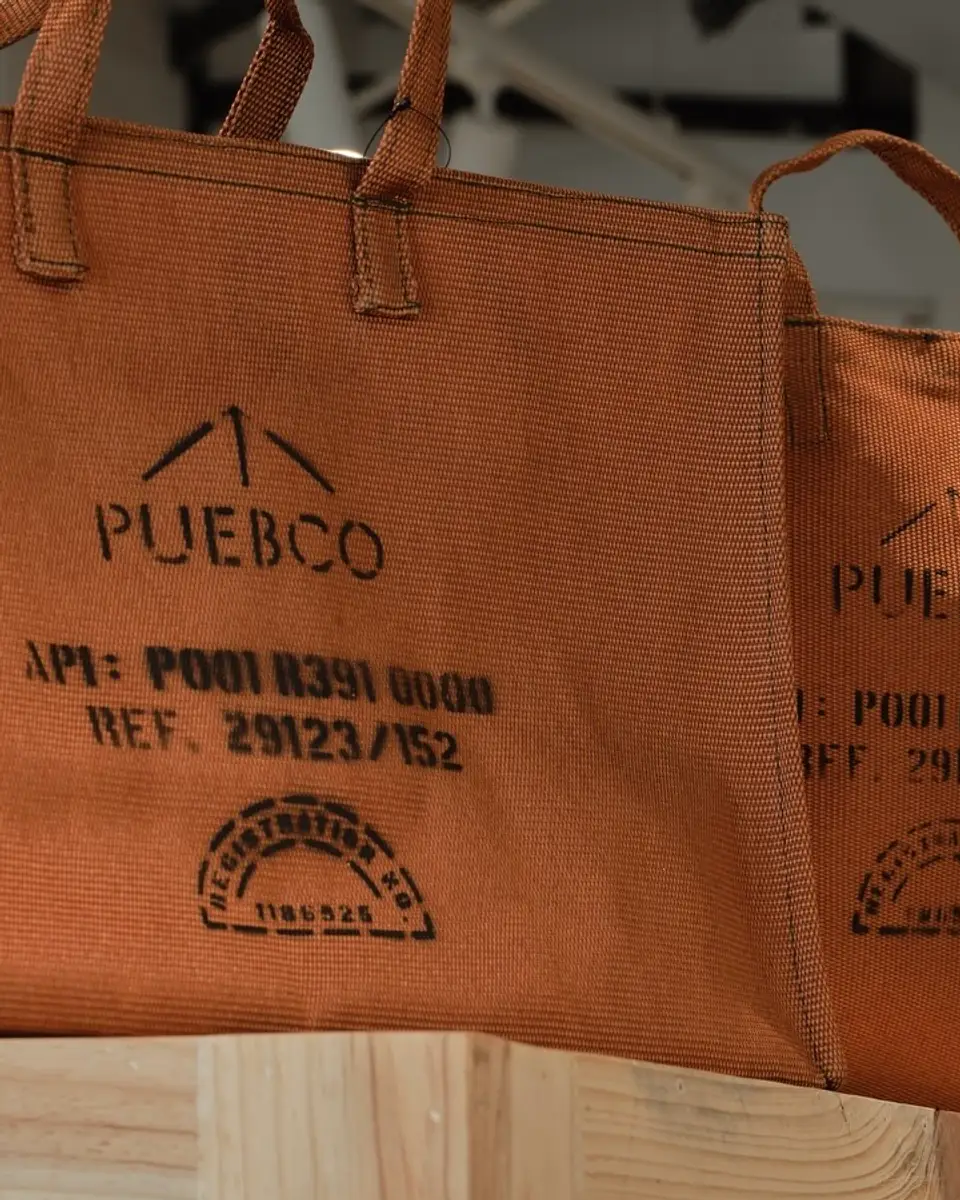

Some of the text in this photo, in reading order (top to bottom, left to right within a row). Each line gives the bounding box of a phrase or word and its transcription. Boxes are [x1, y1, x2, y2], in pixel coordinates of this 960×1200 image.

[95, 502, 384, 580] PUEBCO
[25, 639, 121, 687] API:
[144, 645, 261, 694] P001
[85, 703, 464, 772] REF. 29123/152
[854, 688, 945, 729] P001
